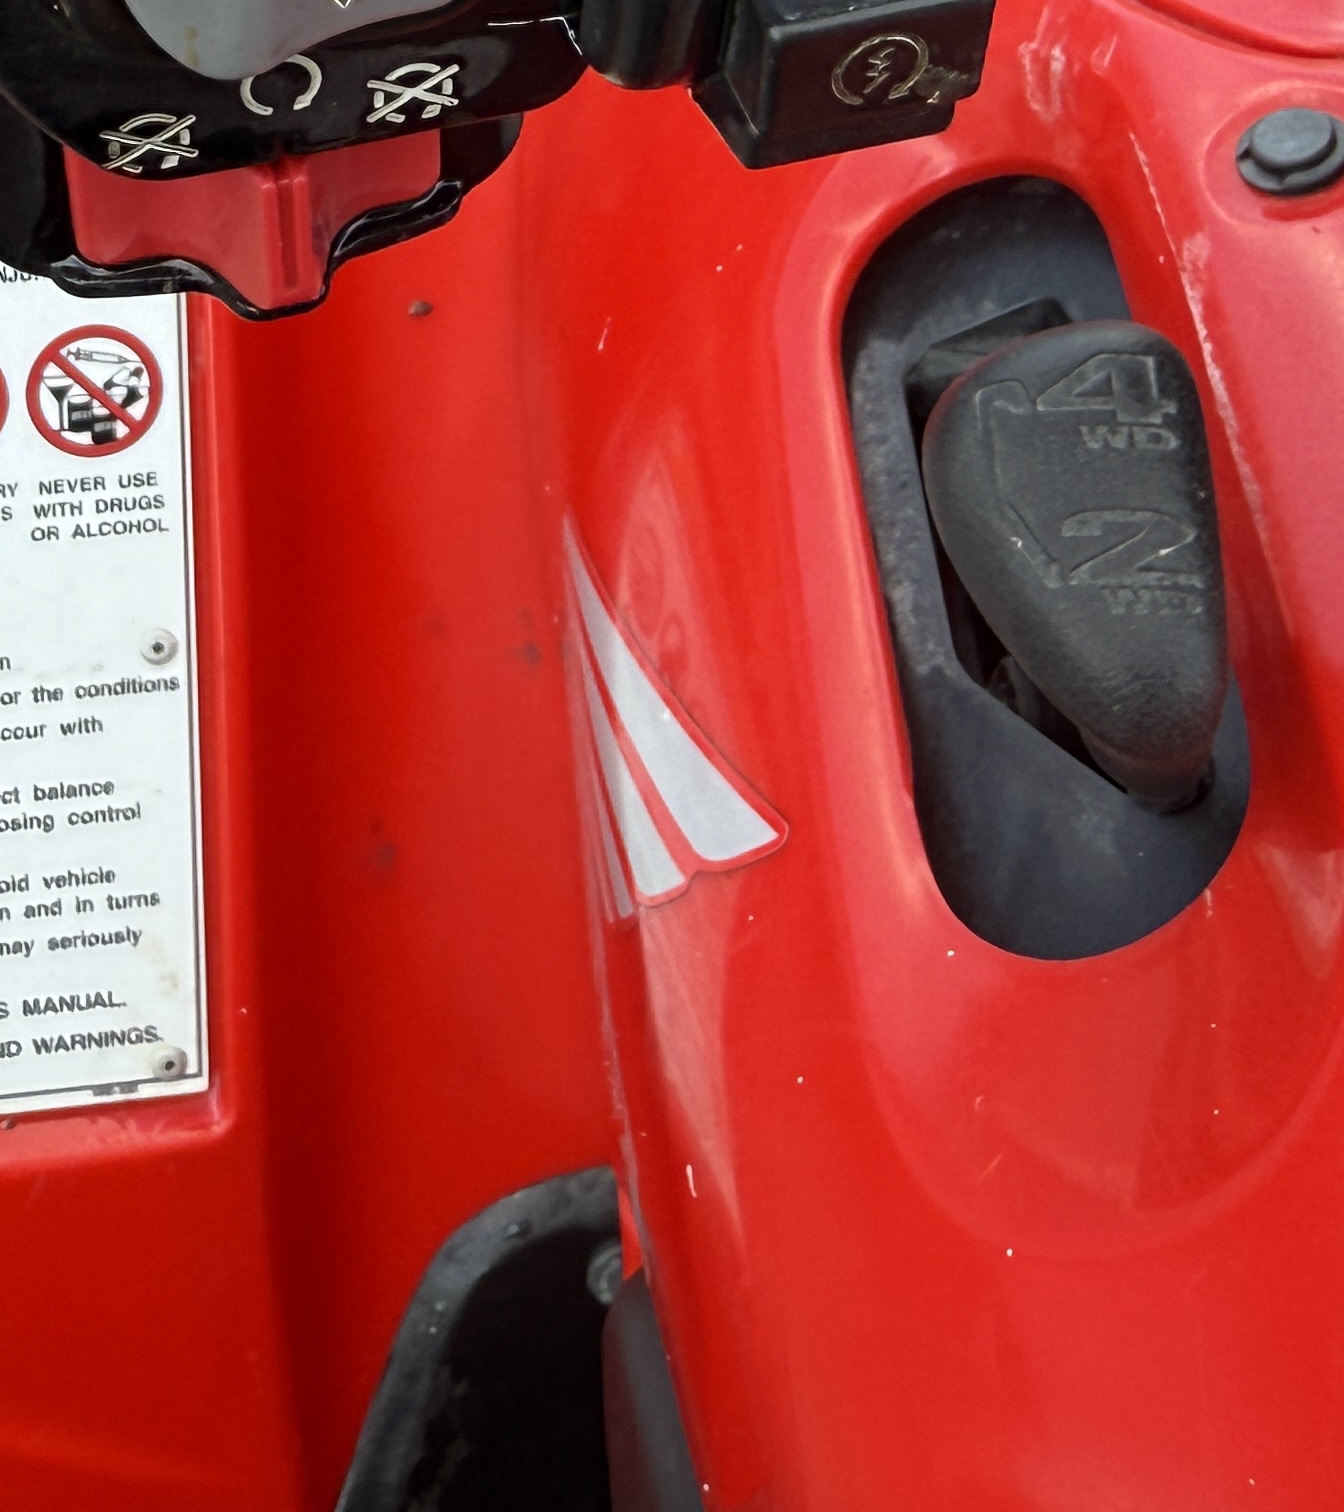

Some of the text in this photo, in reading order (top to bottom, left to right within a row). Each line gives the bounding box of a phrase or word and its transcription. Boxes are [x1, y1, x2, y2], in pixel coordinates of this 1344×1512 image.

[1036, 353, 1177, 424] 4
[1080, 424, 1181, 450] WD
[39, 472, 158, 495] NEVER USE
[33, 494, 165, 519] WITH DRUGS
[31, 518, 169, 541] OR ALCOHOL
[1061, 509, 1204, 587] 2
[0, 691, 21, 706] or
[31, 685, 63, 703] the
[74, 676, 180, 699] conditions
[60, 716, 103, 736] with
[34, 781, 114, 801] balance
[68, 802, 141, 826] control
[43, 867, 115, 889] vehicle
[24, 898, 62, 919] and
[76, 896, 94, 914] in
[106, 893, 160, 911] turns
[48, 926, 142, 951] seriously
